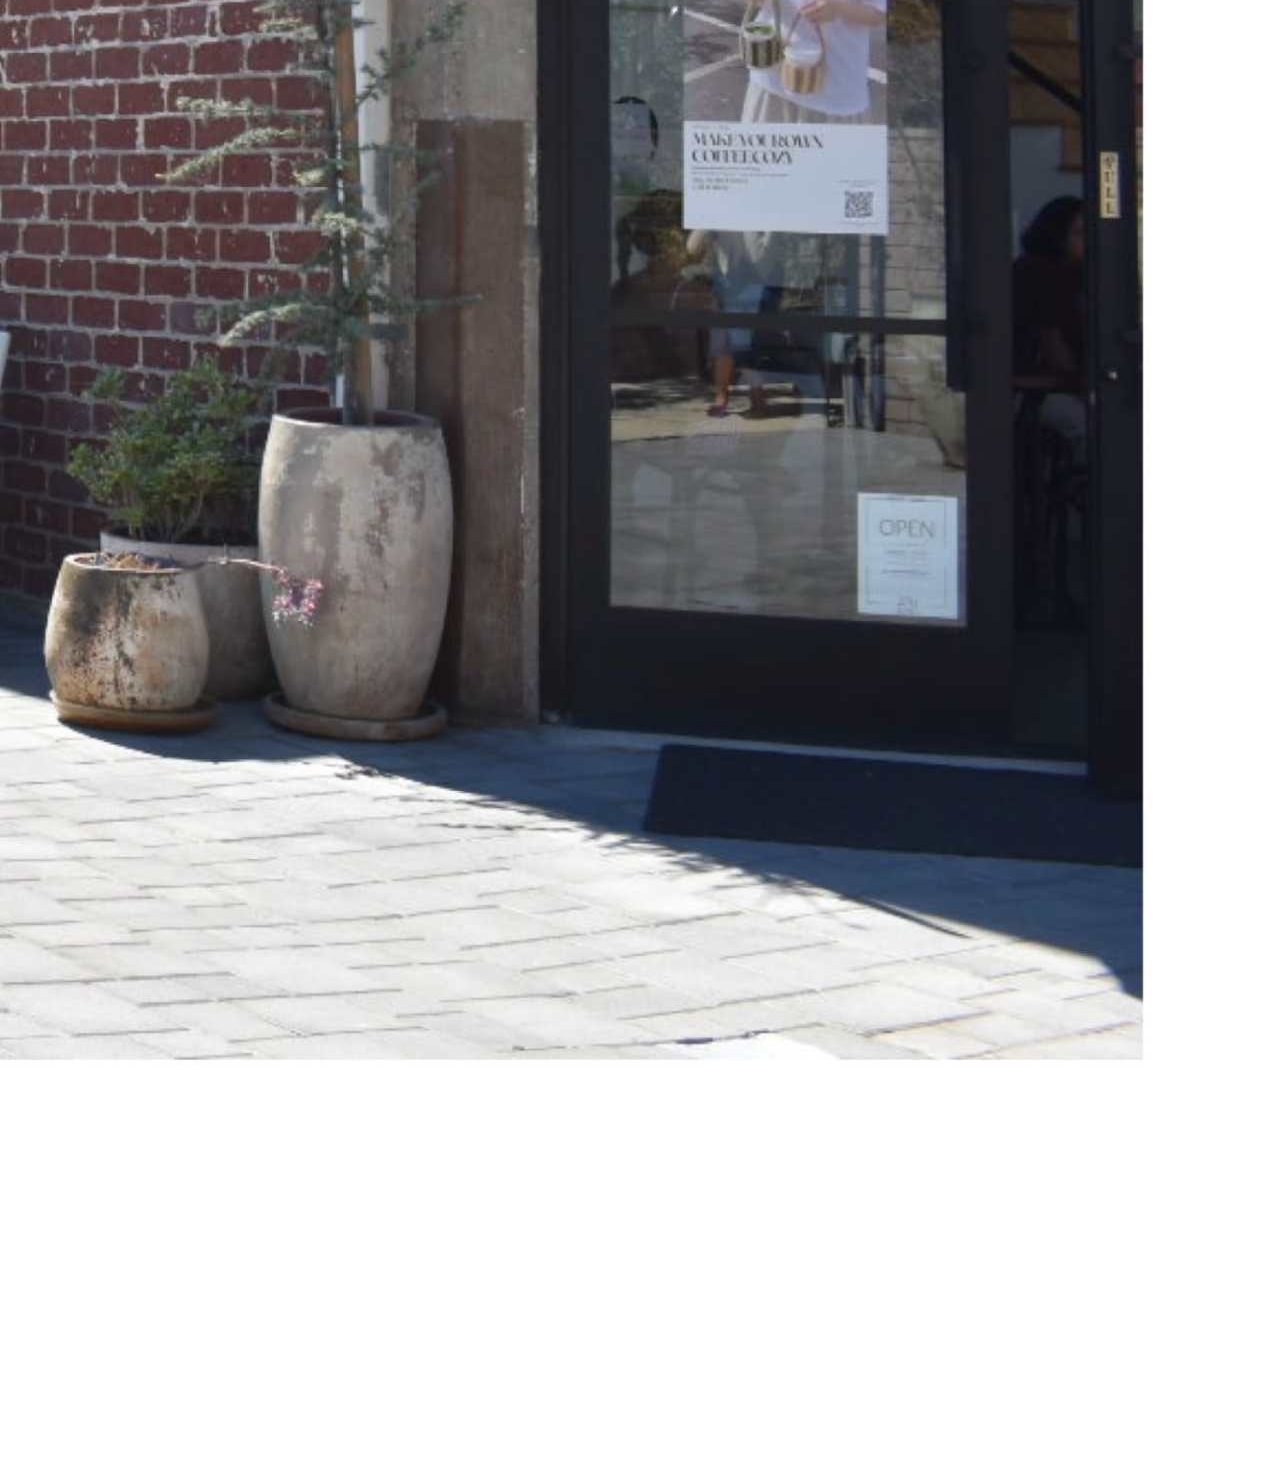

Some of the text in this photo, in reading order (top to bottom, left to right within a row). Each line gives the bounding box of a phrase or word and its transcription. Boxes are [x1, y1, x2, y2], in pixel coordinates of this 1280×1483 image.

[693, 132, 733, 147] MAKE
[691, 148, 748, 164] COFFEE
[879, 518, 936, 538] OPEN
